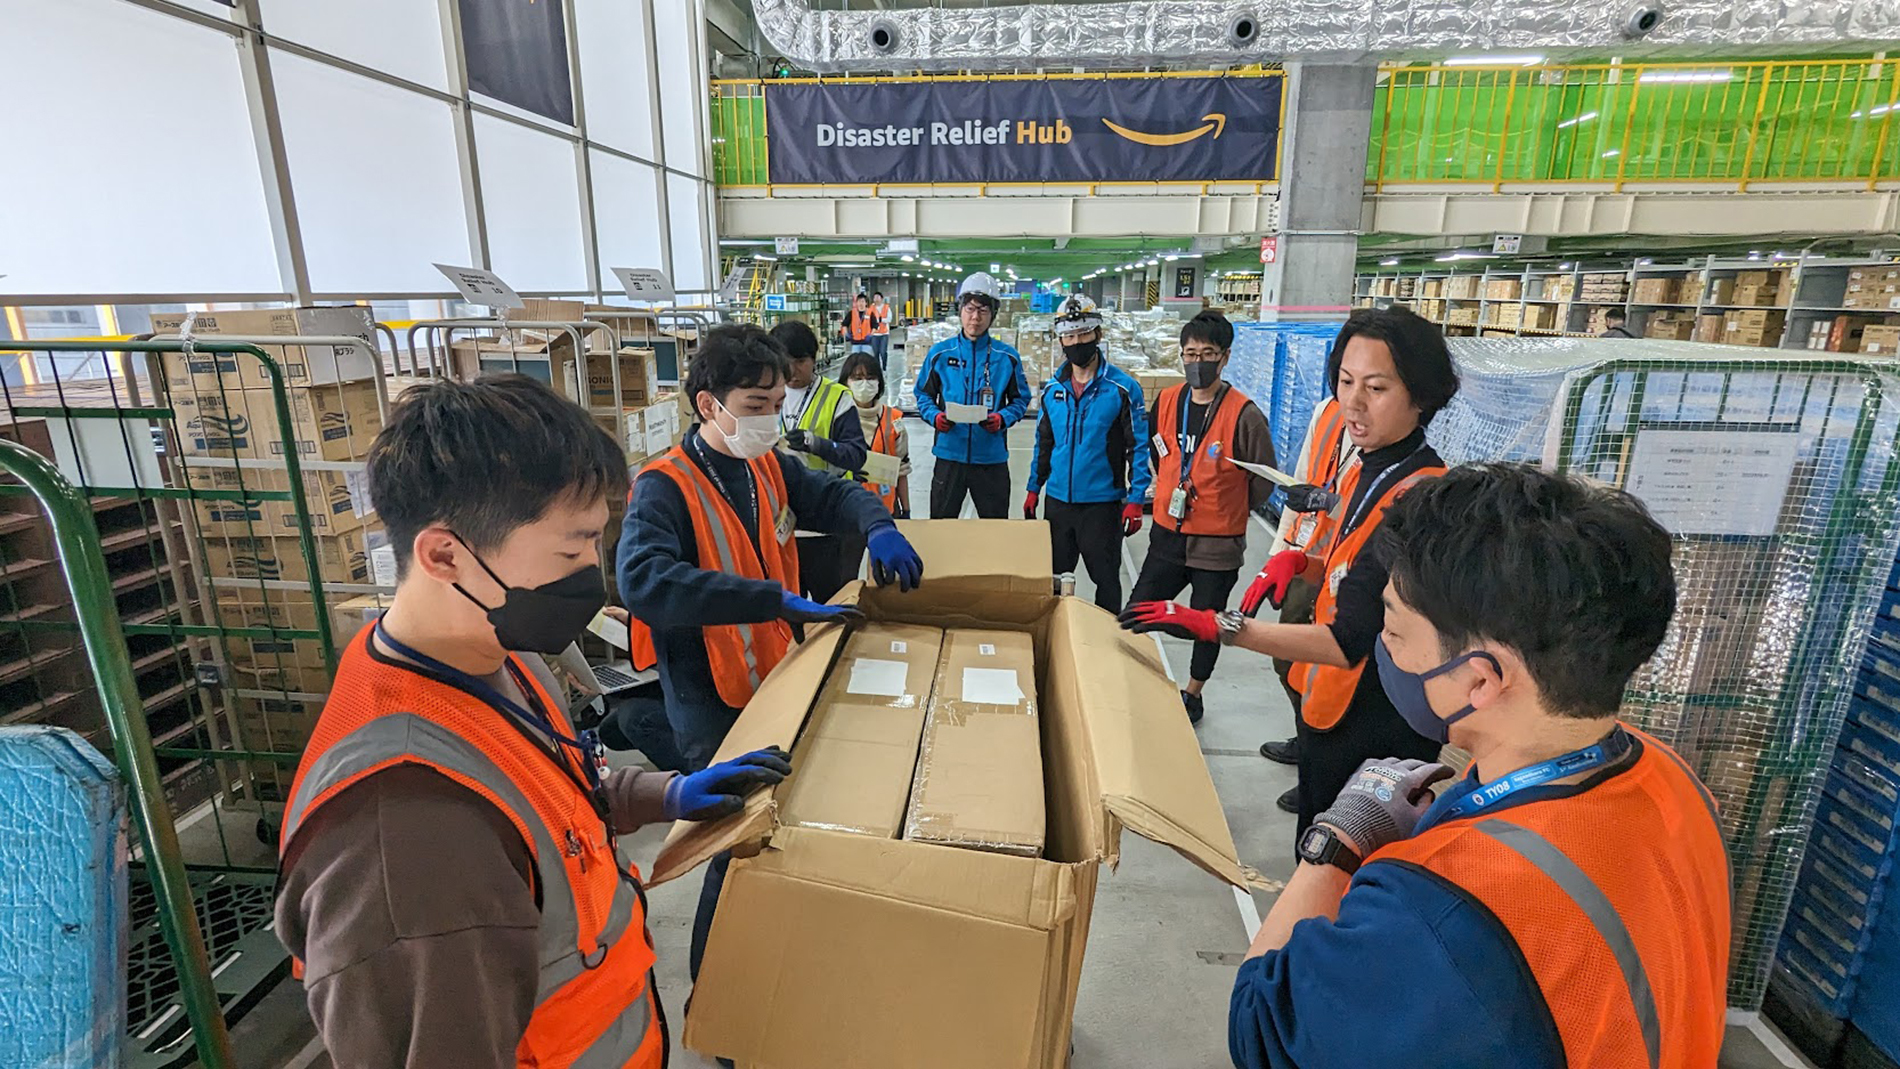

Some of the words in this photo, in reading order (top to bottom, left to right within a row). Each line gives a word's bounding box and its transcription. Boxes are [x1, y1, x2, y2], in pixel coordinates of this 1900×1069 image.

[816, 122, 924, 147] Disaster
[930, 119, 1010, 145] Relief
[1016, 119, 1072, 145] Hub
